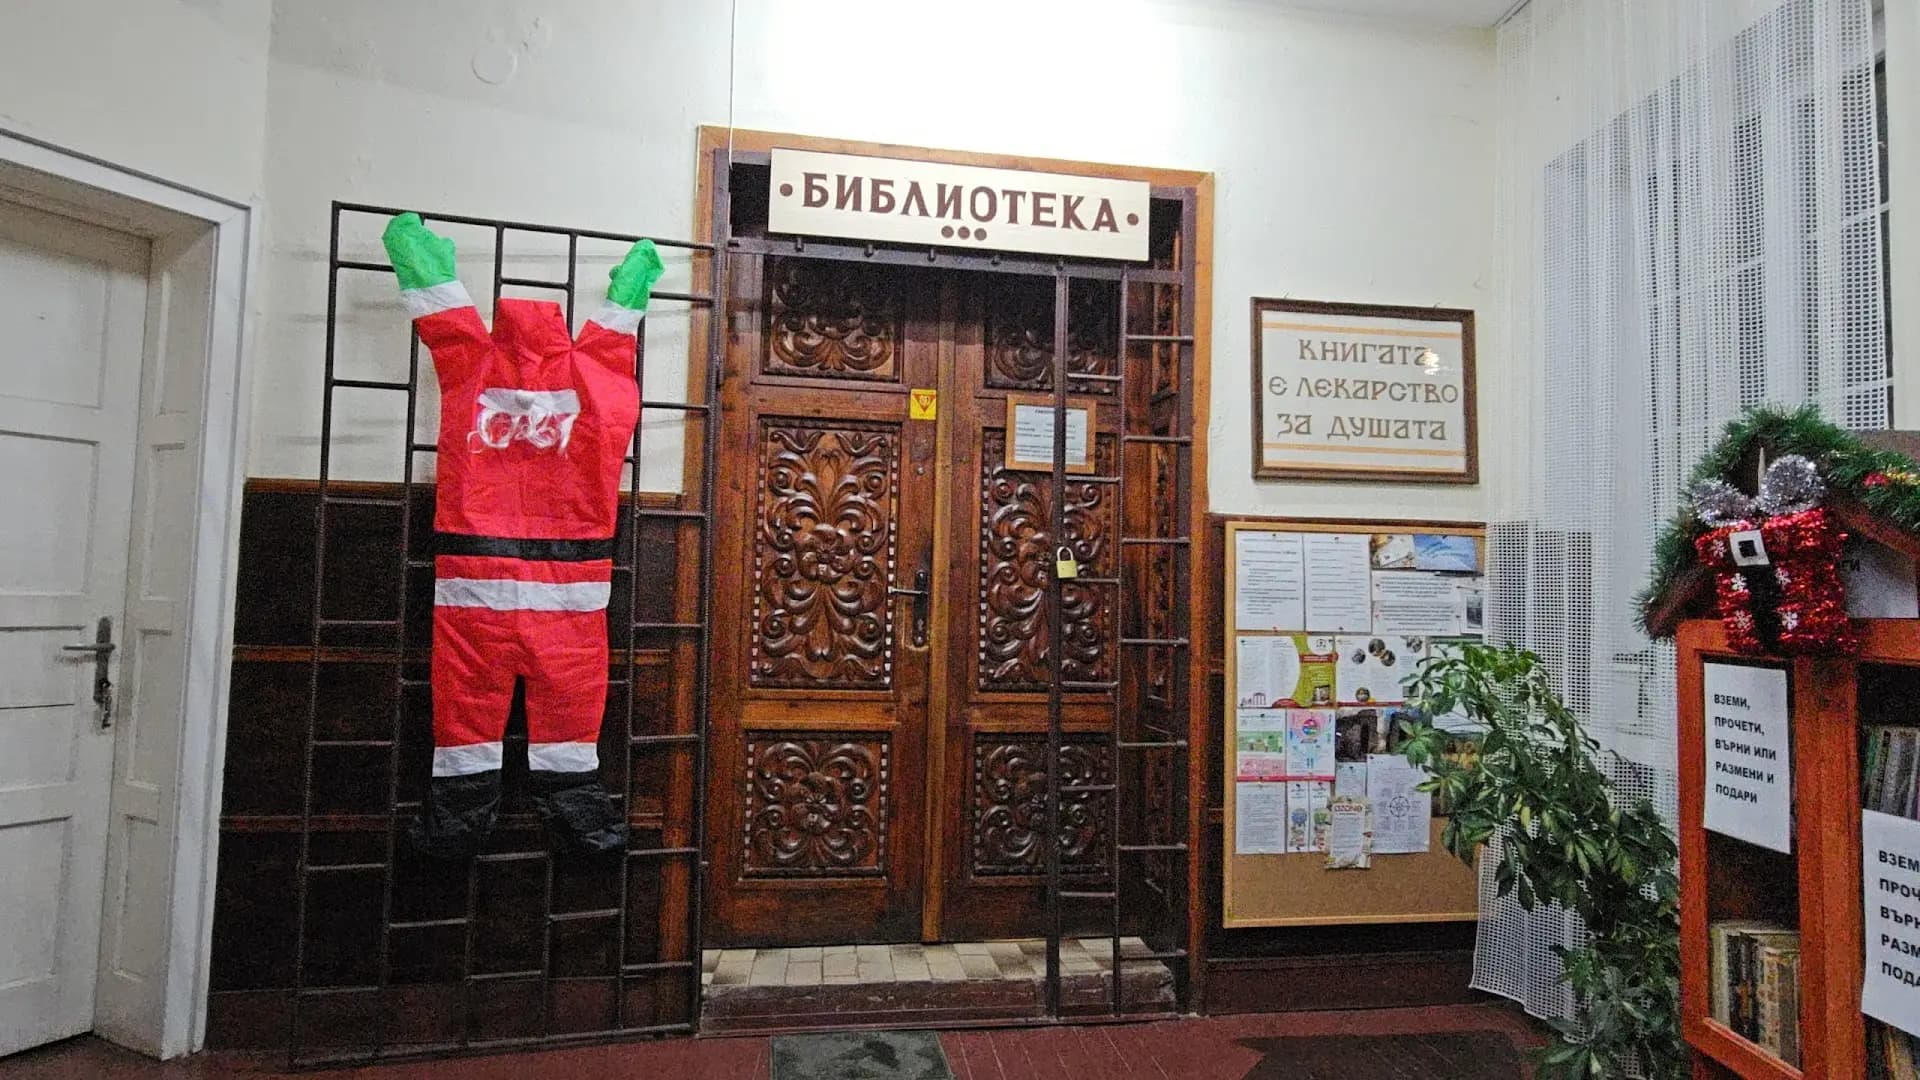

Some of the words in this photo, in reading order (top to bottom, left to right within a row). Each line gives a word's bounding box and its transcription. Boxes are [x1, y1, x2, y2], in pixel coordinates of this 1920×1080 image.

[802, 172, 1120, 233] БИБЛИОТЕКА
[1298, 338, 1437, 366] КНИГАТА
[1296, 377, 1459, 404] ЛЕКАРСТВО
[1277, 413, 1312, 439] ЗА
[1327, 415, 1448, 441] ДУШАТА
[1713, 694, 1751, 711] ВЗЕМИ,
[1714, 716, 1765, 737] ПРОЧЕТИ,
[1715, 738, 1751, 756] ВЪРНИ
[1754, 745, 1777, 761] ИЛИ
[1715, 761, 1764, 782] РАЗМЕНИ
[1767, 772, 1775, 785] И
[1715, 783, 1758, 804] ПОДАРИ
